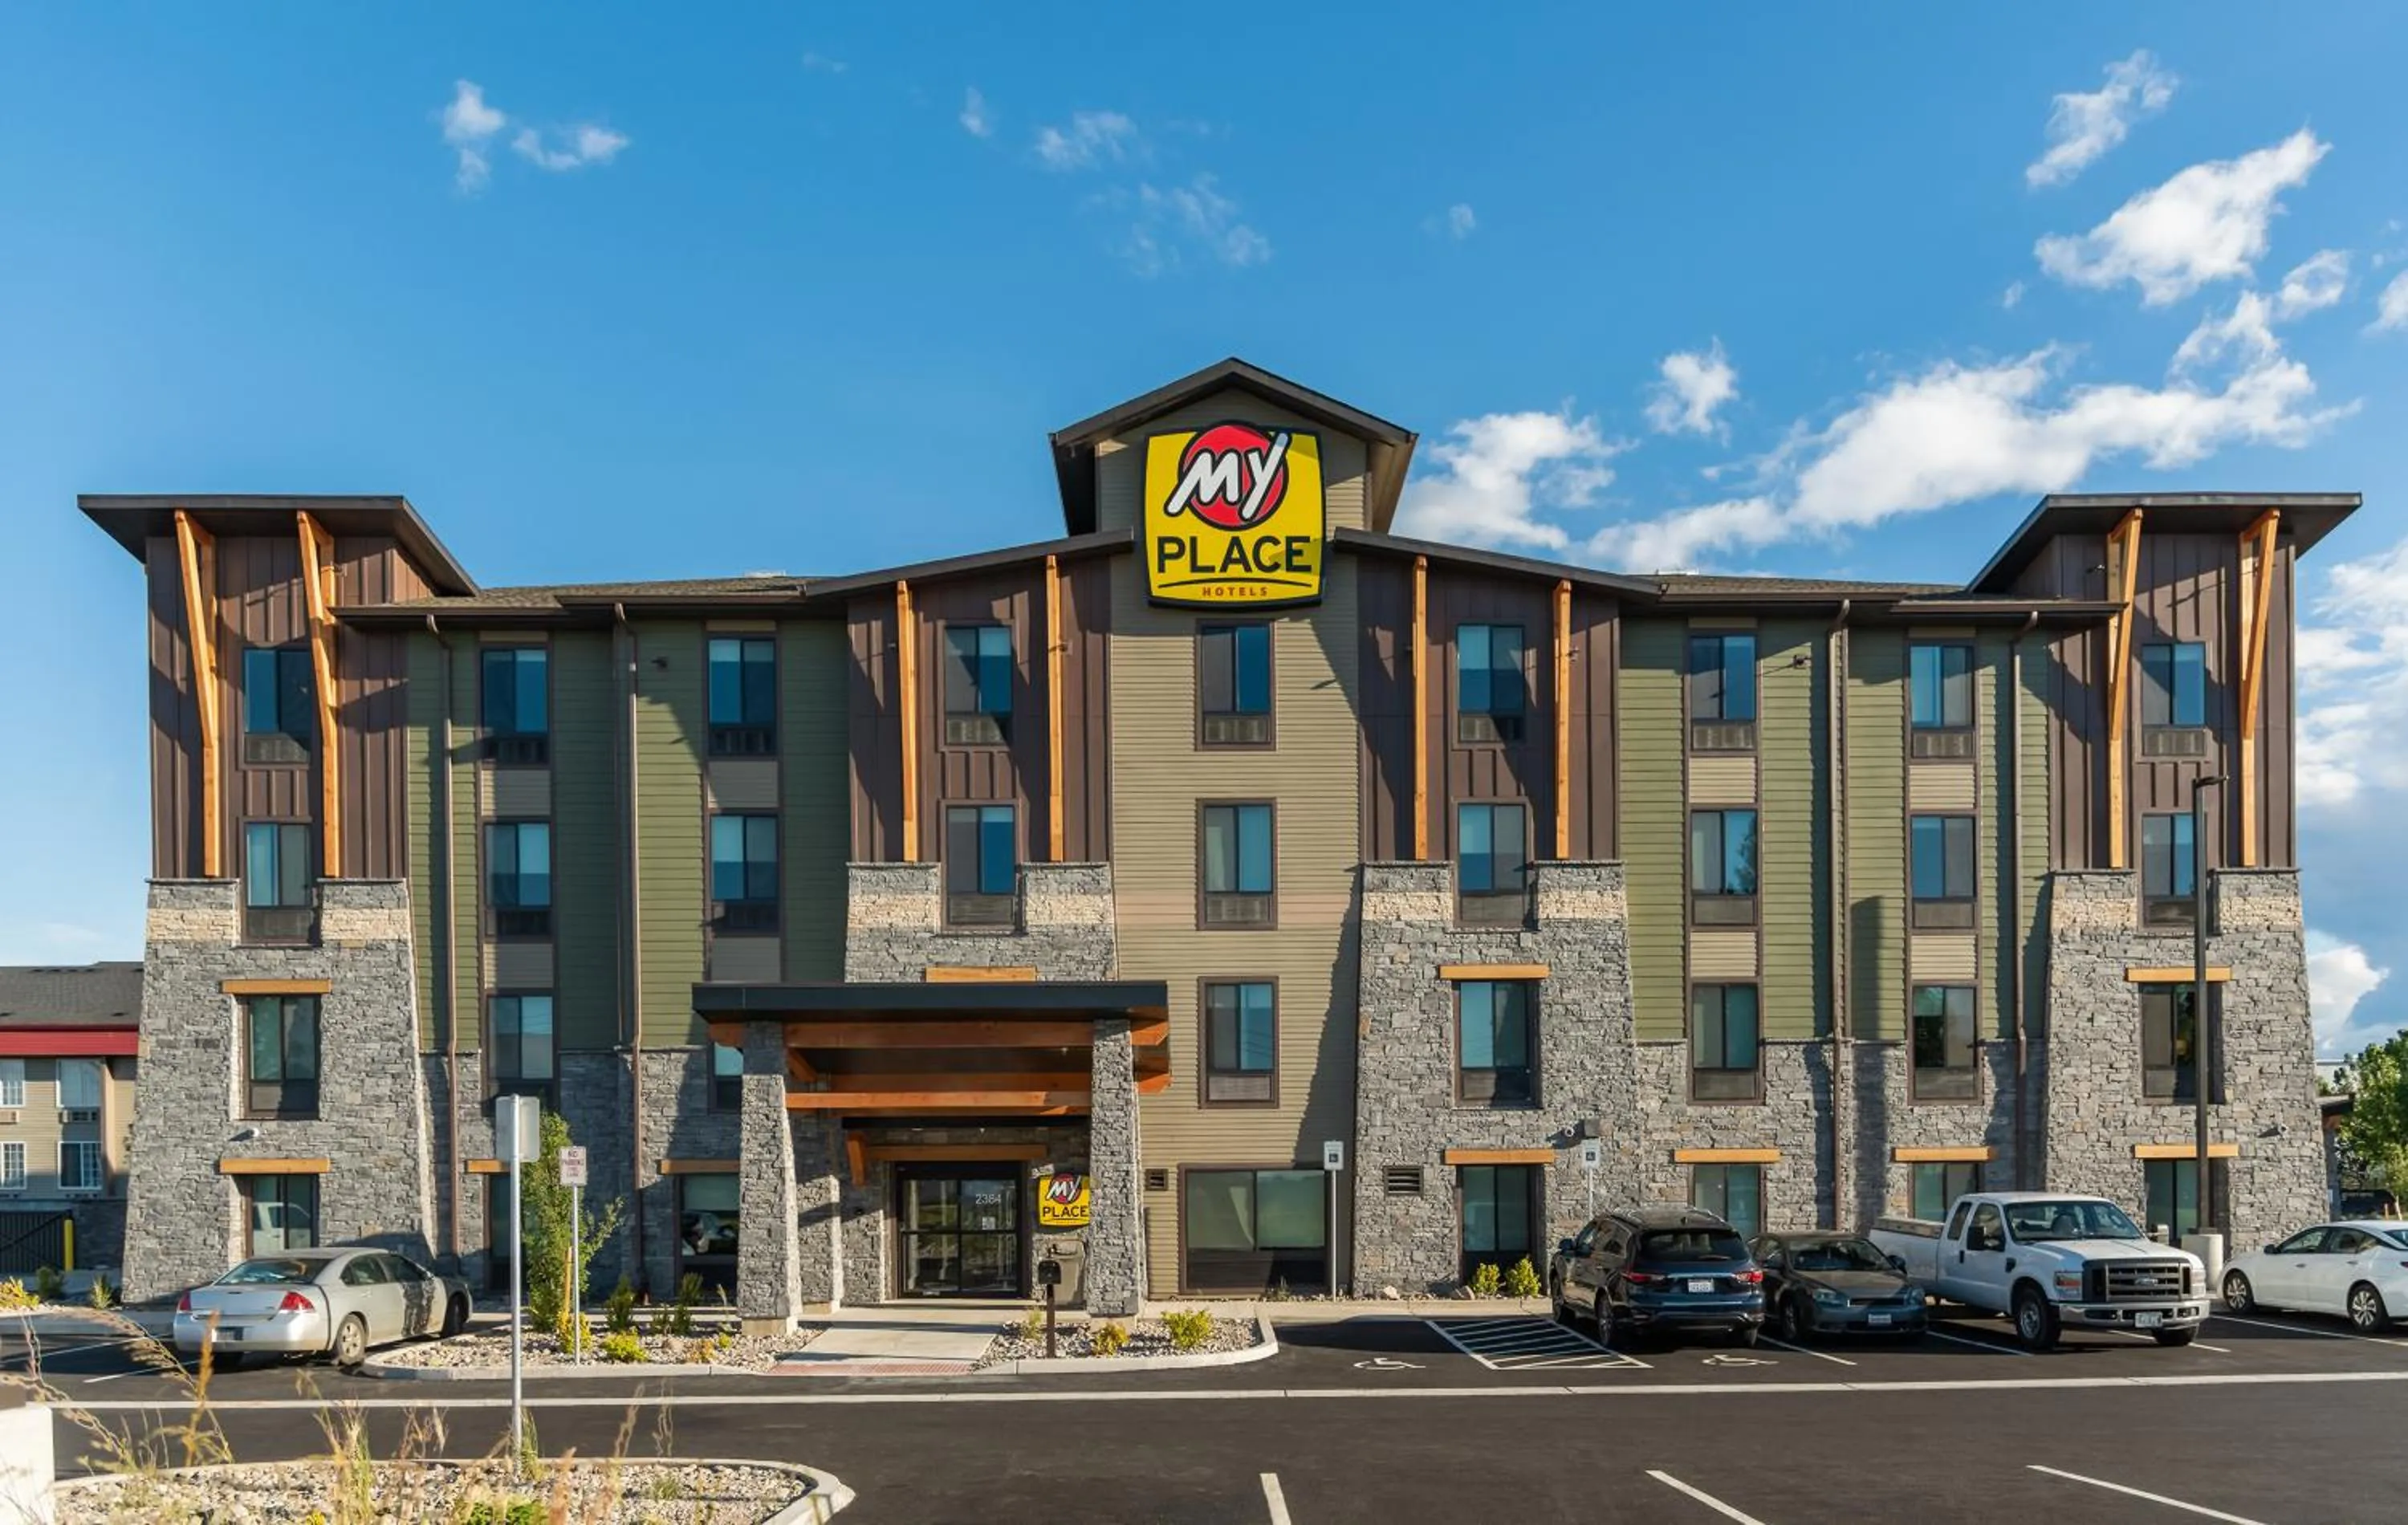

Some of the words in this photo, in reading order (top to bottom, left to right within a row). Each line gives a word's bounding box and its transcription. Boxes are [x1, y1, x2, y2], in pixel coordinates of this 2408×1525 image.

[1157, 535, 1312, 574] PLACE
[1202, 586, 1268, 597] HOTELS
[975, 1194, 1001, 1205] 2384
[1043, 1206, 1089, 1218] PLACE
